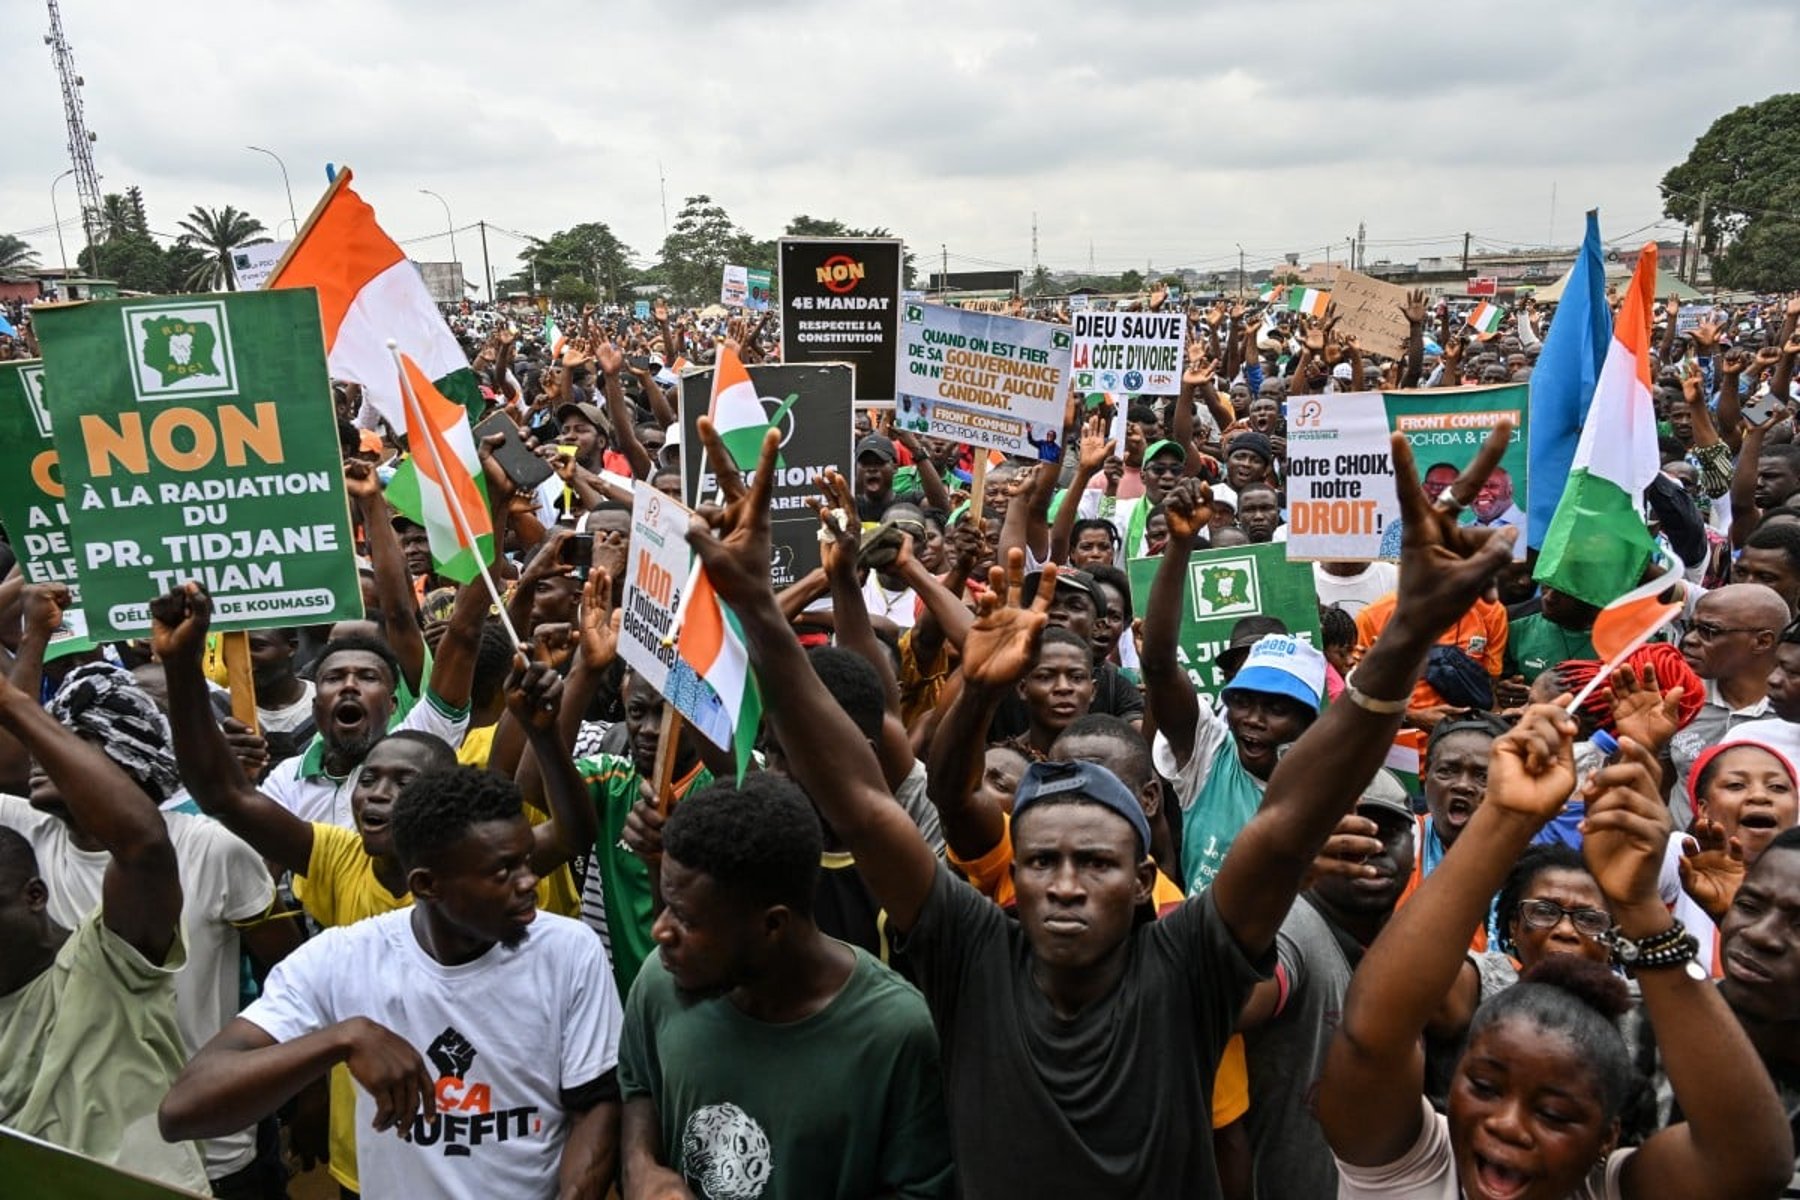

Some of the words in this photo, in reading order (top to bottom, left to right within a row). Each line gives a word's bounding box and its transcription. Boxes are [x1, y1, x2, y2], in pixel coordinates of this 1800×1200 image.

[815, 262, 865, 284] NON
[791, 297, 813, 310] 4E
[816, 297, 889, 310] MANDAT
[797, 333, 883, 343] CONSTITUTION
[799, 321, 865, 331] RESPECTEZ
[867, 321, 882, 331] LA
[1075, 316, 1117, 338] DIEU
[1122, 316, 1181, 339] SAUVE
[922, 329, 967, 349] QUAND
[970, 337, 988, 351] ON
[992, 341, 1016, 357] EST
[1019, 346, 1049, 364] FIER
[1073, 343, 1089, 368] LA
[1092, 339, 1124, 370] CÔTE
[1126, 344, 1179, 371] D'IVOIRE
[908, 343, 926, 358] DE
[927, 347, 943, 362] SA
[946, 349, 1061, 384] GOUVERNANCE
[910, 362, 928, 376] ON
[930, 365, 1001, 390] N'EXCLUT
[1002, 377, 1055, 401] AUCUN
[938, 382, 1013, 411] CANDIDAT.
[935, 408, 969, 424] FRONT
[972, 415, 1020, 434] COMMUN
[1400, 415, 1446, 430] FRONT
[80, 402, 284, 477] NON
[981, 431, 990, 442] &
[1404, 431, 1461, 446] DCI-RDA
[1465, 431, 1477, 443] &
[1335, 454, 1394, 478] CHOIX,
[81, 483, 105, 510] À
[111, 485, 154, 508] LA
[159, 472, 331, 504] RADIATION
[1311, 478, 1361, 499] notre
[182, 503, 228, 527] DU
[85, 540, 154, 570] PR.
[161, 524, 339, 563] TIDJANE
[637, 549, 672, 608] Non
[671, 588, 680, 614] à
[221, 602, 242, 615] DE
[249, 595, 330, 612] KOUMASSI
[629, 584, 680, 645] l'injustic
